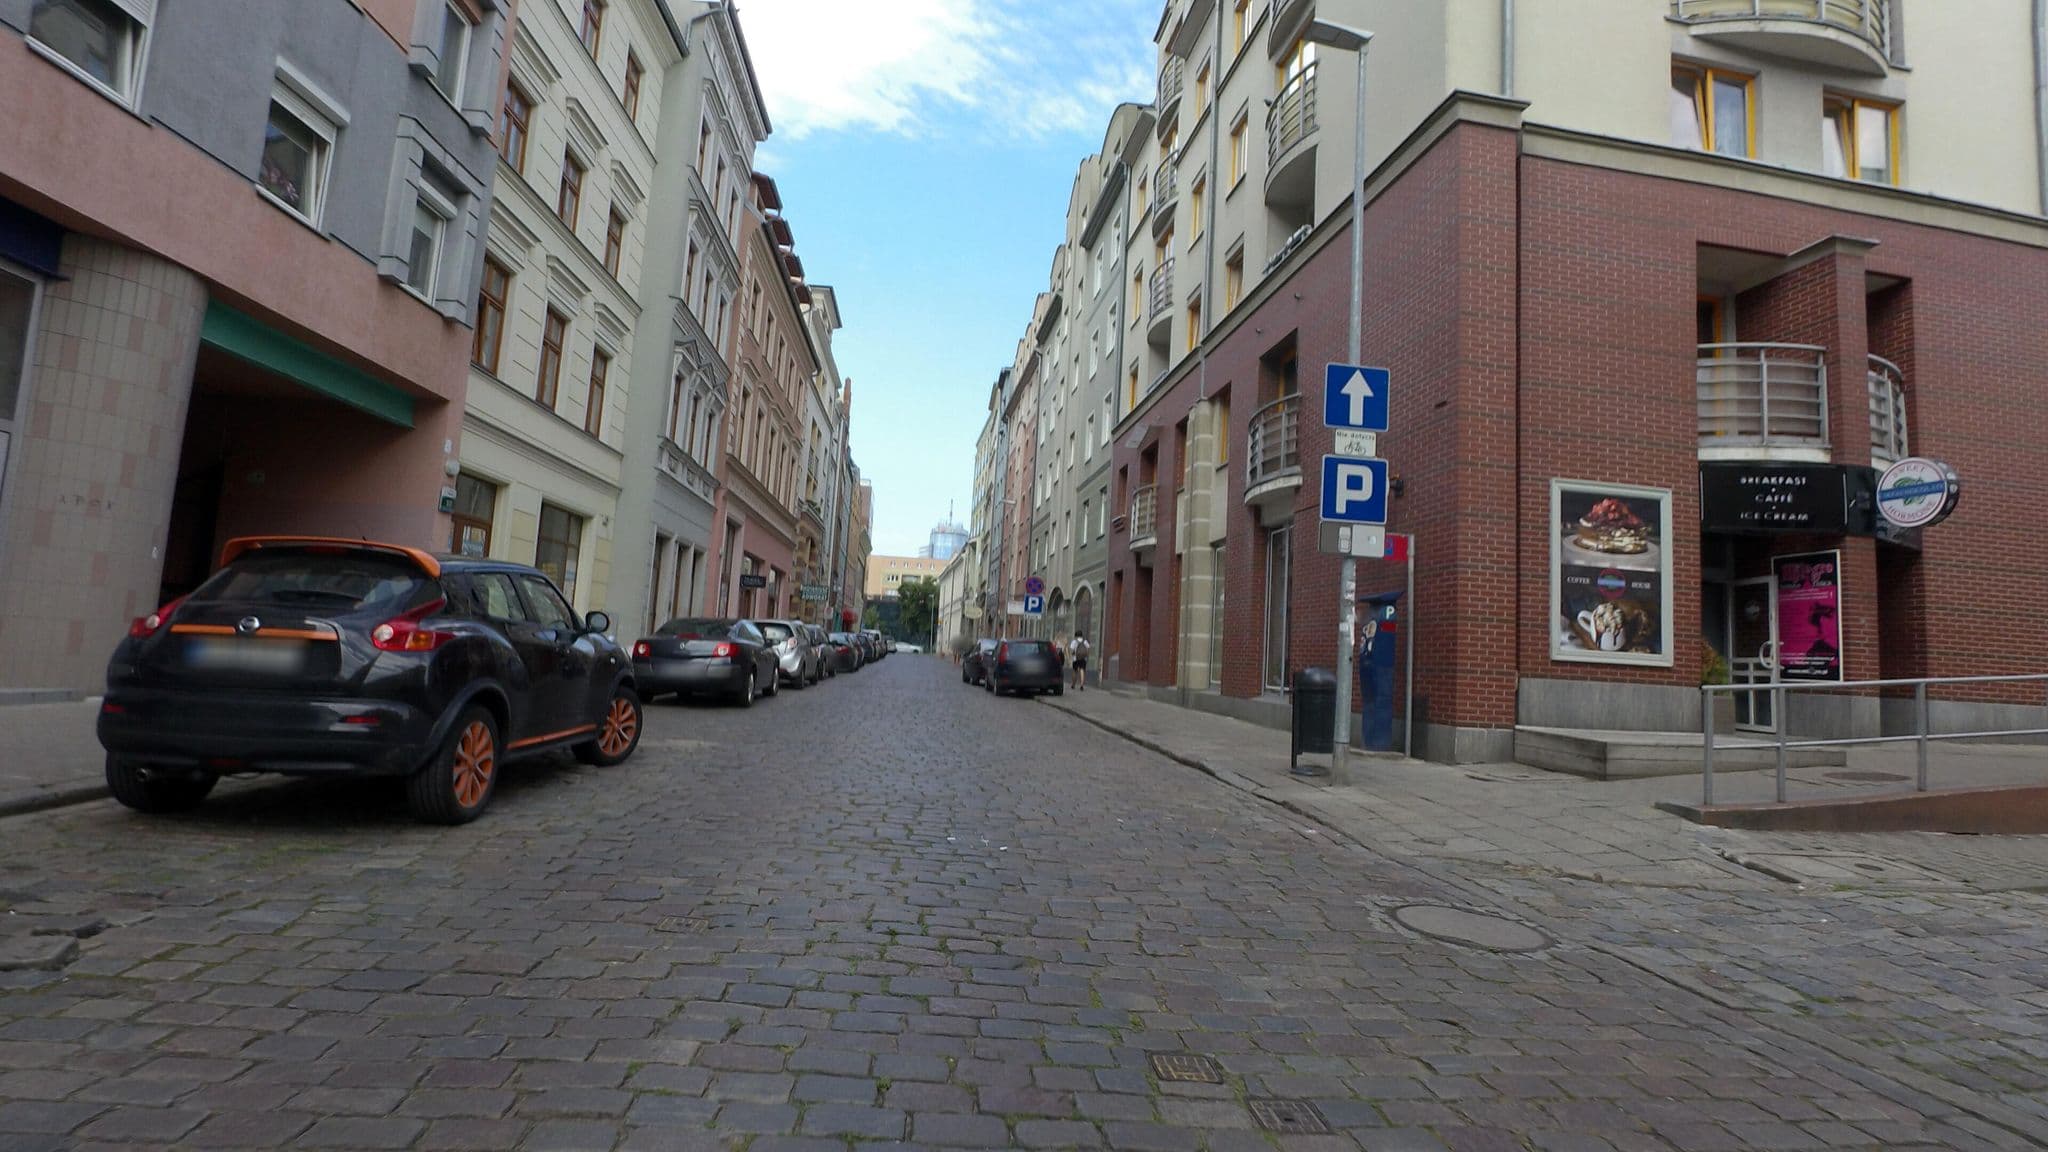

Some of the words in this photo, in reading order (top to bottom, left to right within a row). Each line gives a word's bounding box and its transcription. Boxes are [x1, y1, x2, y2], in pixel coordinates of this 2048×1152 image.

[1336, 463, 1373, 514] P
[1740, 476, 1807, 486] BREAKFAST
[1740, 512, 1760, 520] ICE
[1764, 512, 1808, 521] CREAM
[1028, 596, 1040, 611] P
[1385, 605, 1396, 620] P
